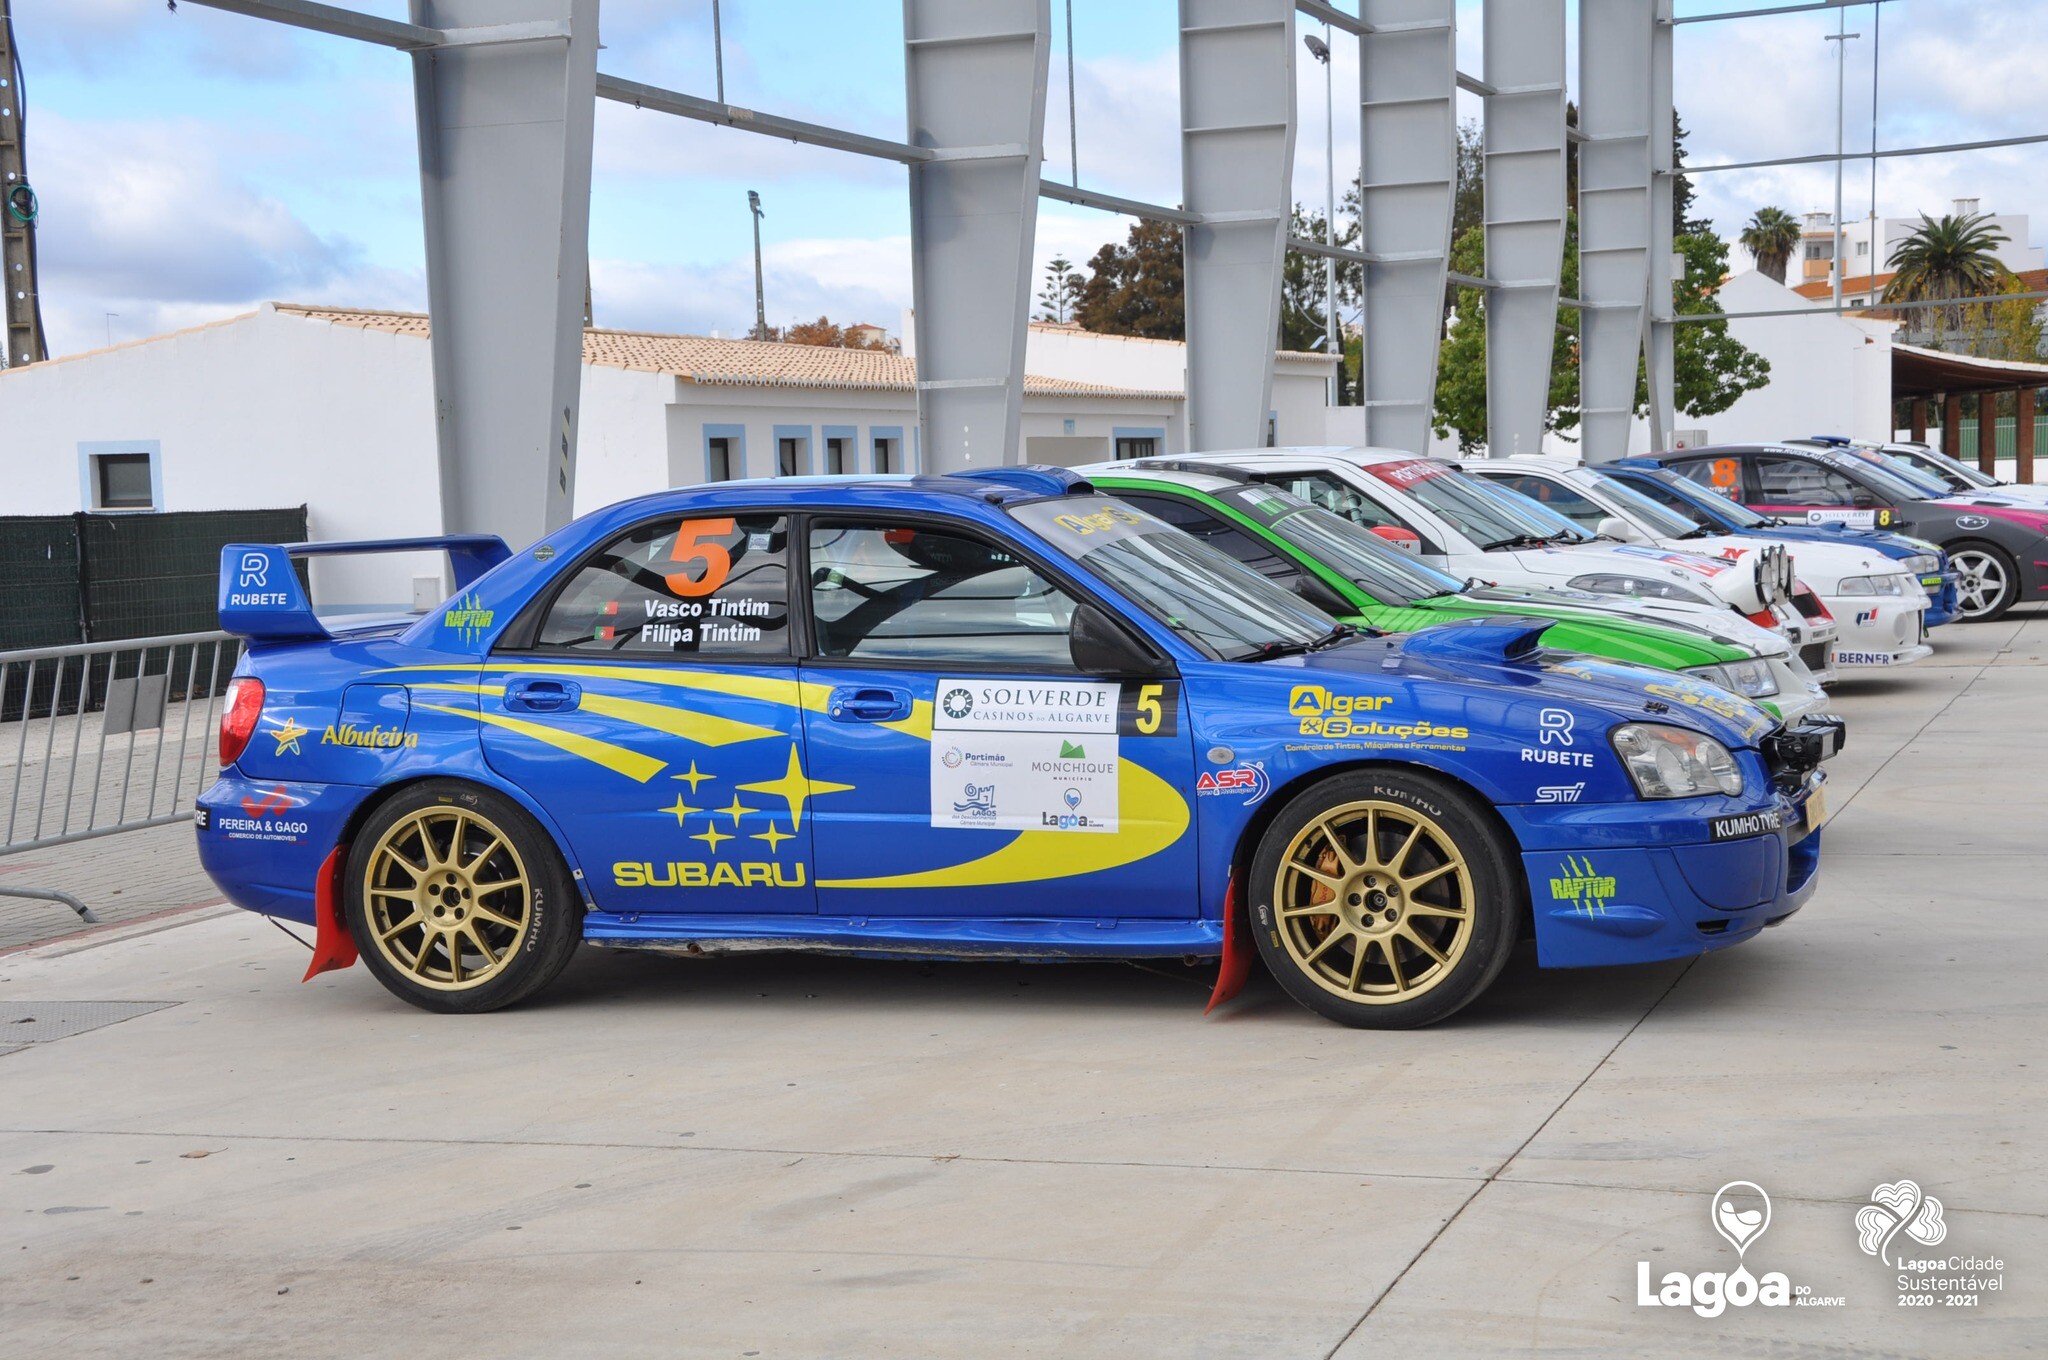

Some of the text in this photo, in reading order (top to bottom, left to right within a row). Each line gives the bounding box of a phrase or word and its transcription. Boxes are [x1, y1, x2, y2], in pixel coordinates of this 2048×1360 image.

[1711, 458, 1737, 486] 8
[1879, 510, 1890, 526] 8
[665, 517, 735, 597] 5
[231, 593, 286, 606] RUBETE
[645, 598, 770, 617] Vasco Tintim
[444, 610, 495, 628] RAPTOR
[641, 623, 761, 646] Filipa Tintim
[1839, 653, 1889, 664] BERNER
[981, 688, 1107, 707] SOLVERDE
[1289, 685, 1393, 716] Algar
[973, 711, 1034, 722] CASINOS
[1048, 712, 1110, 723] ALGARVE
[1135, 684, 1164, 734] 5
[320, 724, 419, 750] Albufeira
[1322, 717, 1469, 739] Soluções
[1285, 744, 1323, 752] Comércio
[1364, 741, 1403, 750] Máquinas
[1410, 742, 1466, 752] Ferramentas
[965, 753, 1005, 762] Portimão
[1521, 749, 1594, 767] RUBETE
[1031, 762, 1114, 774] MONCHIQUE
[1197, 769, 1258, 789] ASR
[972, 809, 997, 817] LAGOS
[1042, 812, 1088, 829] Lagoa
[219, 818, 308, 834] PEREIRA & GAGO
[1715, 812, 1780, 838] KUMHO TYRE
[228, 832, 255, 840] COMERCIO
[263, 834, 297, 842] AUTOMOVEIS
[612, 862, 806, 887] SUBARU
[1550, 877, 1616, 900] RAPTOR
